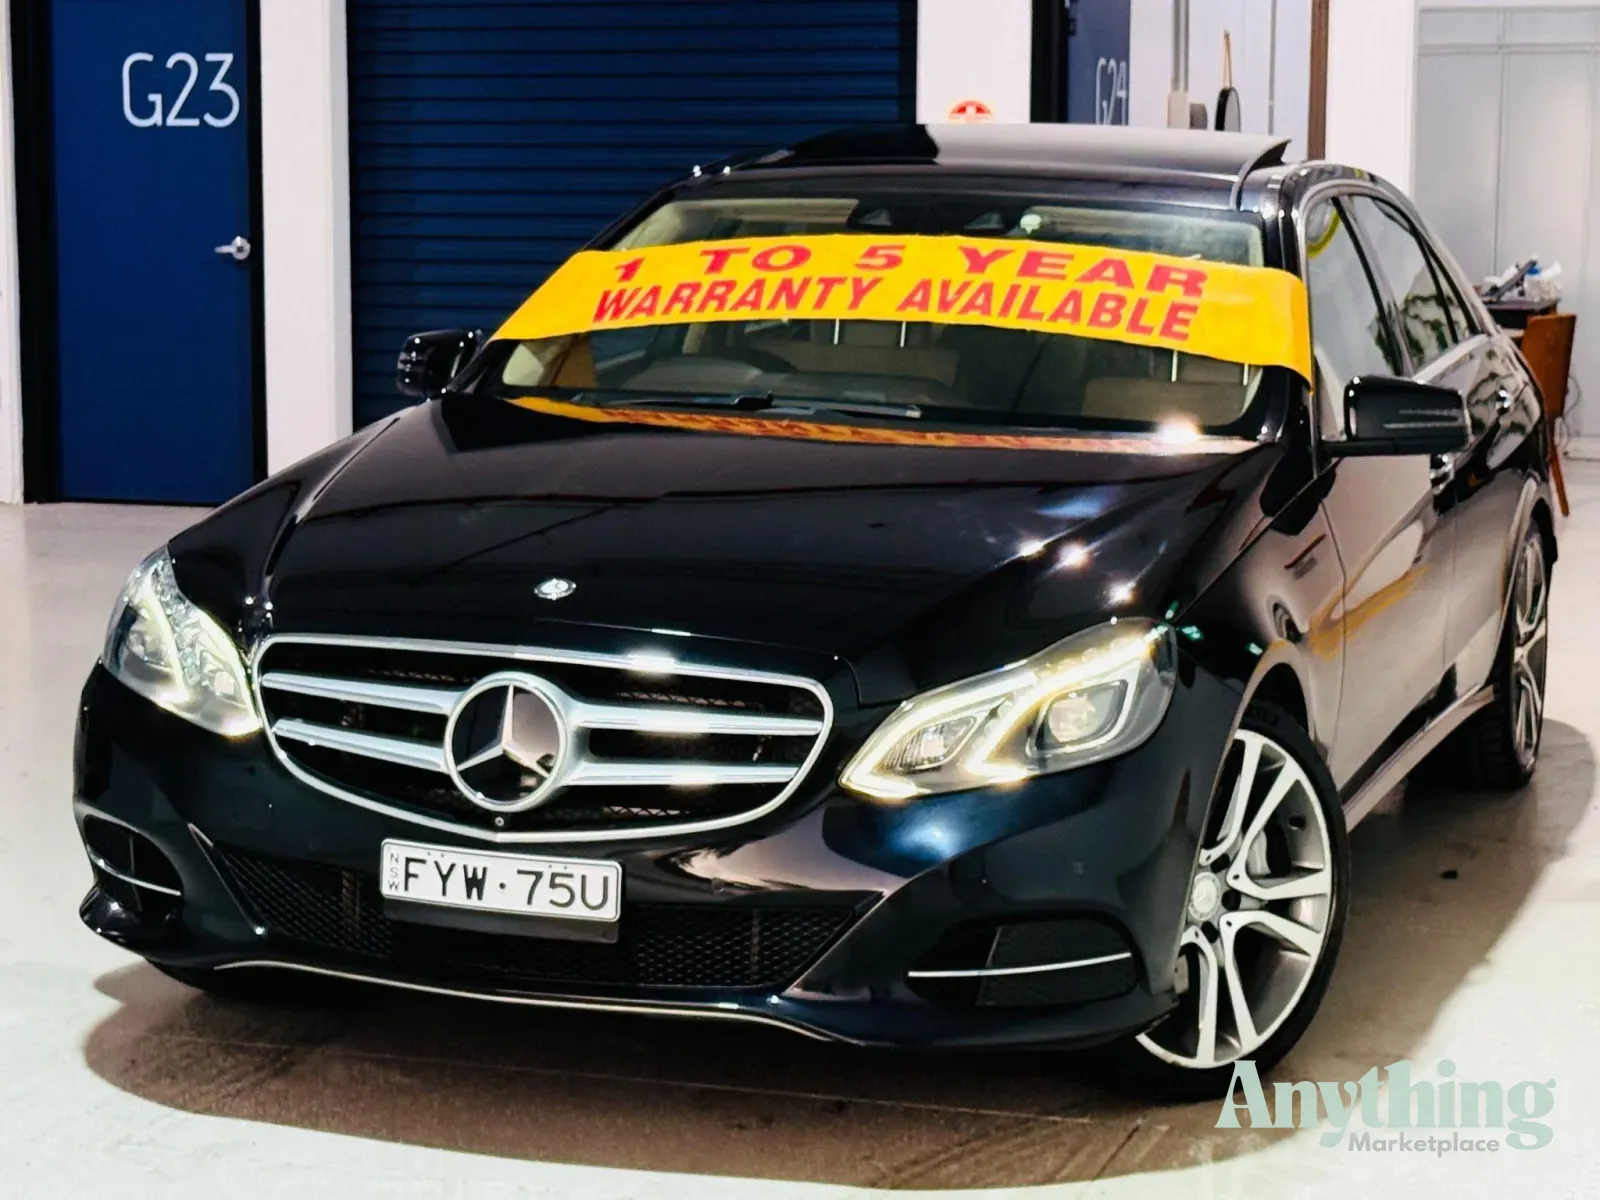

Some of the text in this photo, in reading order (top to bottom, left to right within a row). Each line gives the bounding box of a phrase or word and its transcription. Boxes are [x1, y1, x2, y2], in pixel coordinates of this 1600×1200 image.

[122, 52, 240, 128] G23
[1096, 57, 1128, 125] G24
[615, 245, 1208, 297] 1 TO 5 YEAR
[593, 277, 1199, 341] WARRANTY AVAILABLE
